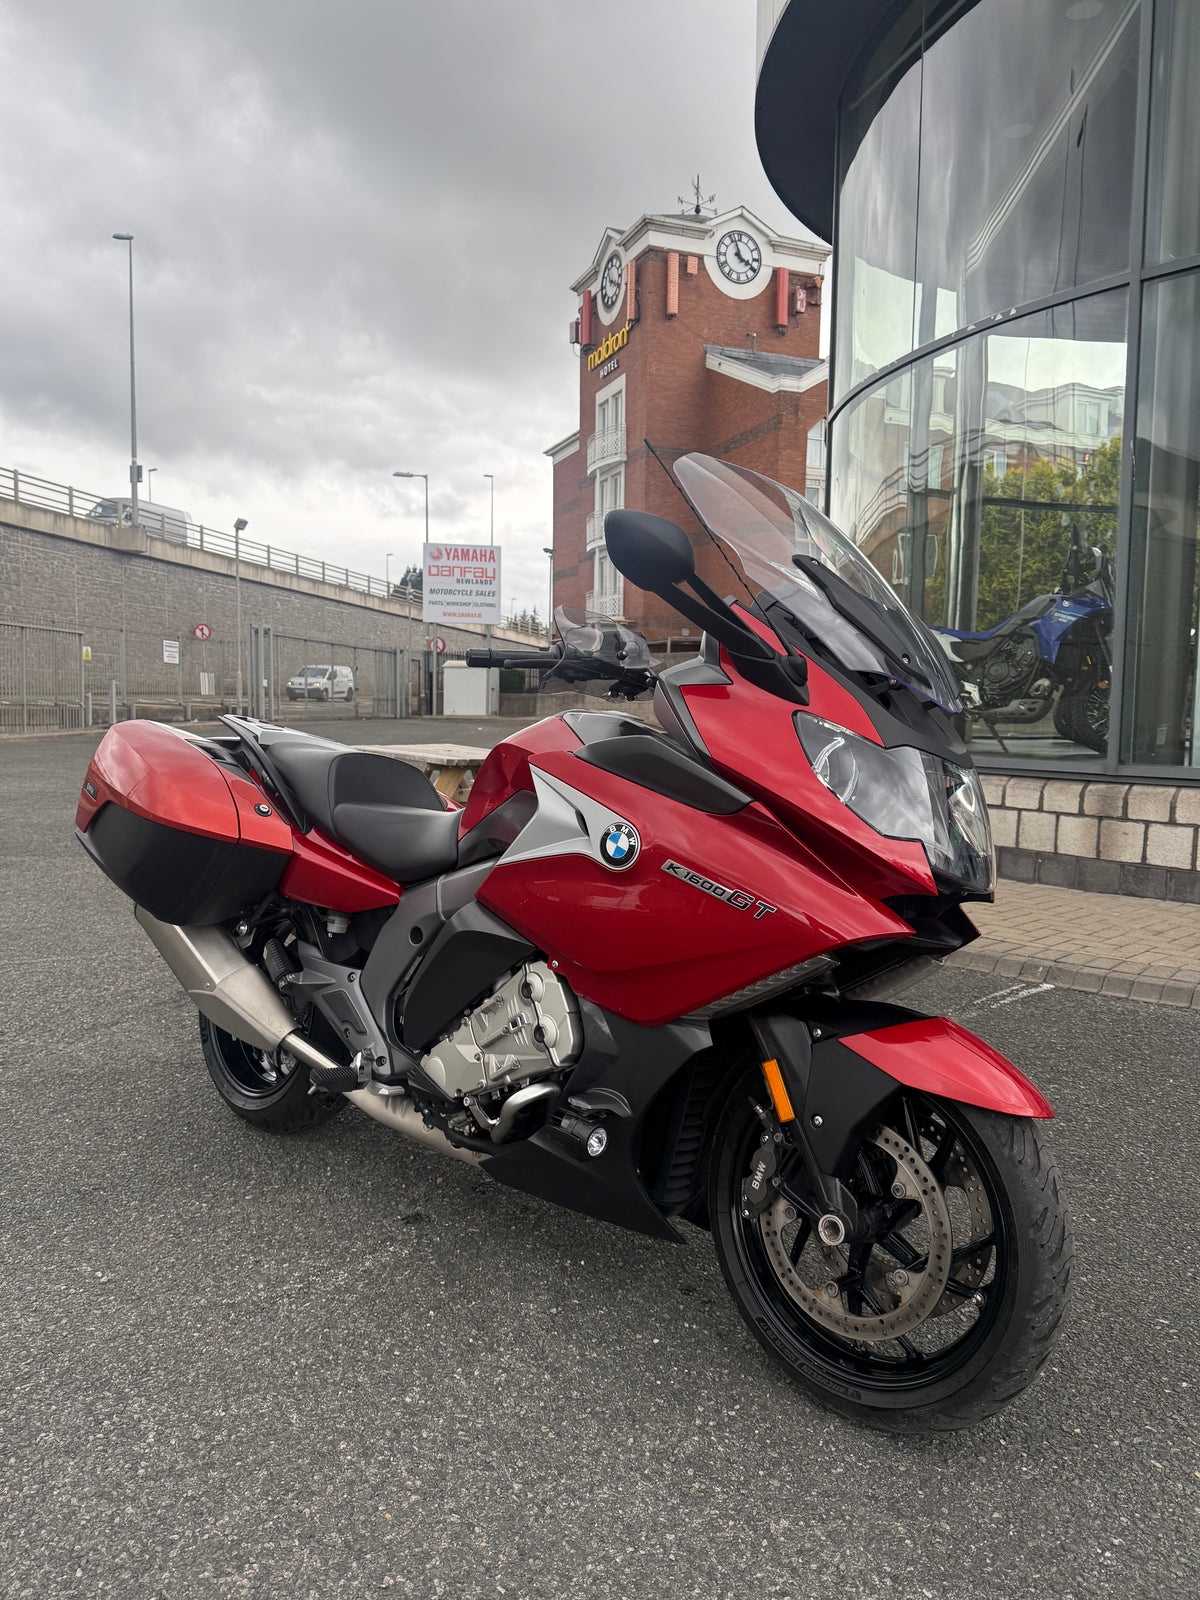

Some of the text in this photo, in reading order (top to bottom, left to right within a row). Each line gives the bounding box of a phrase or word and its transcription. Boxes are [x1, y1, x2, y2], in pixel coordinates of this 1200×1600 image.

[587, 328, 628, 372] maldron
[600, 359, 618, 379] HOTEL
[444, 547, 496, 563] YAMAHA
[429, 588, 473, 597] MOTORCYCLE
[609, 825, 636, 846] BMW
[751, 1160, 766, 1190] BMW
[801, 1363, 847, 1395] MICHELIN
